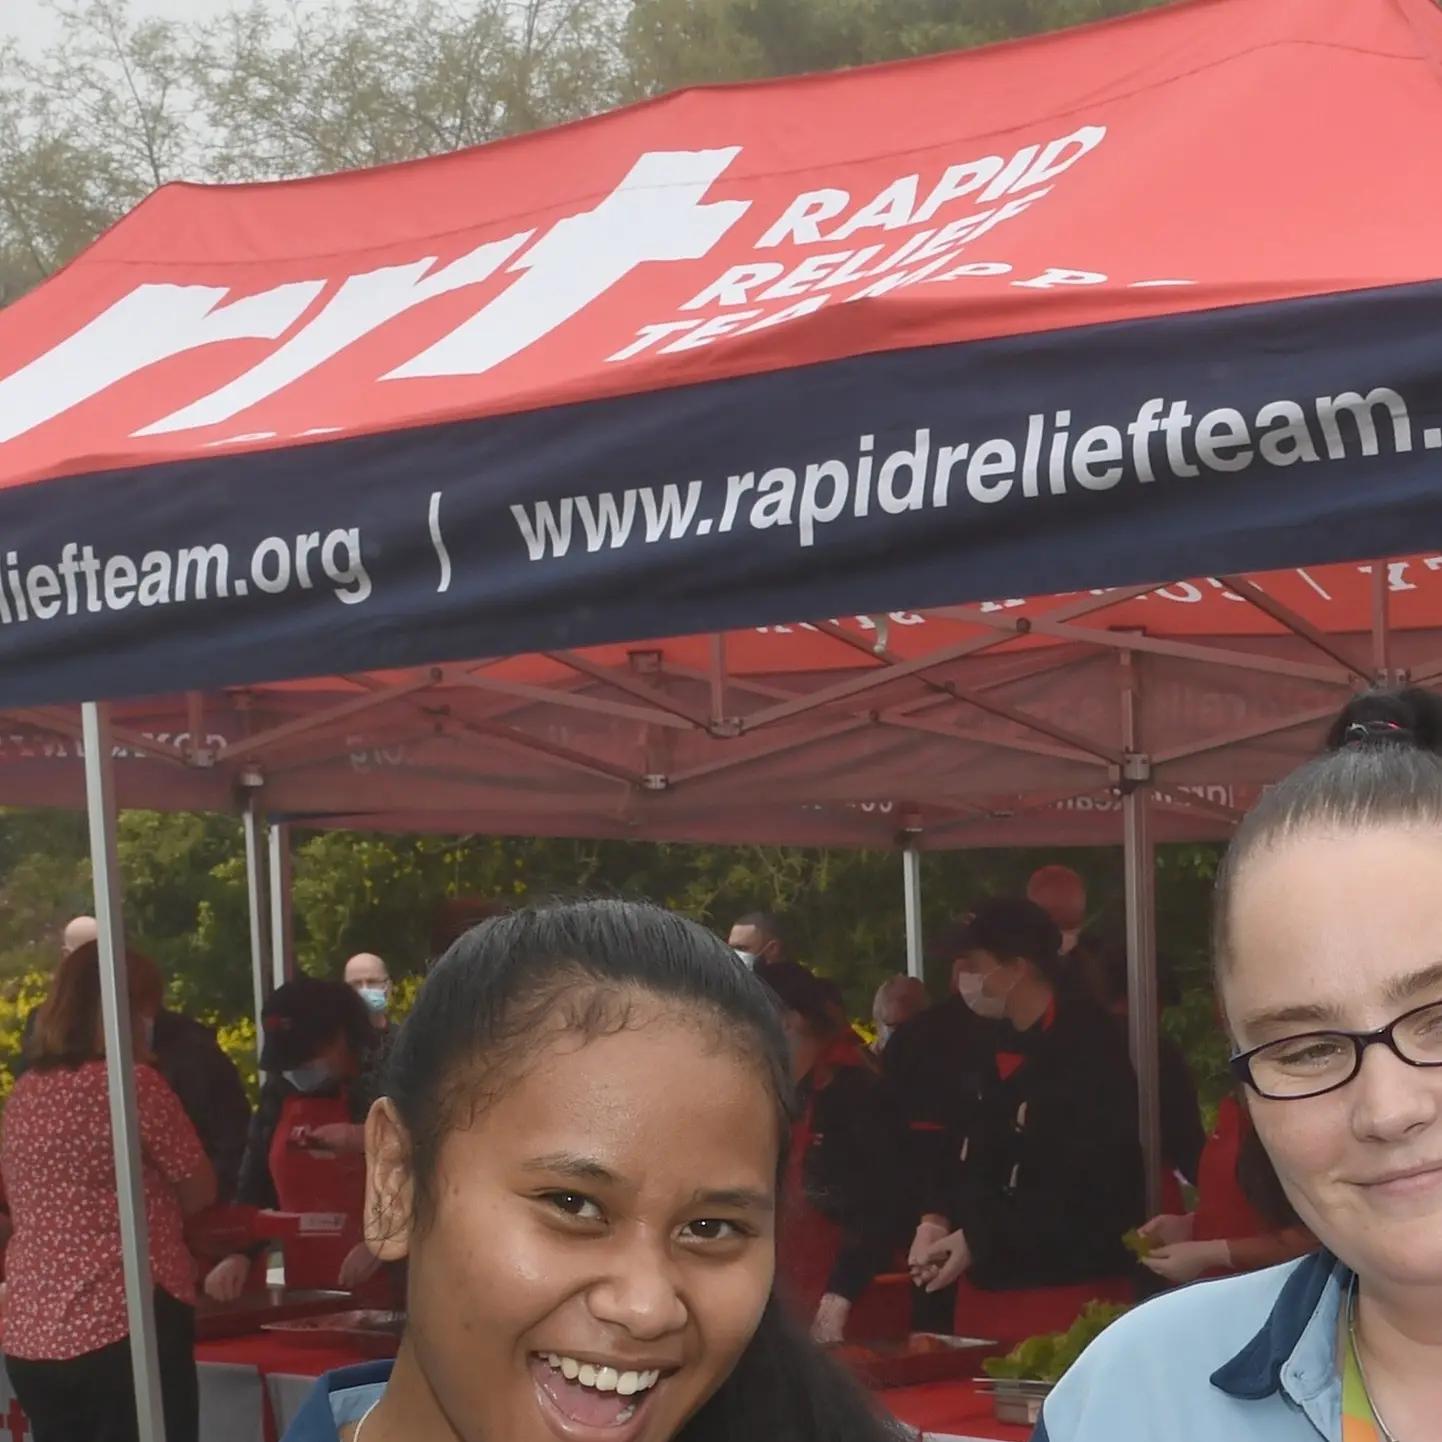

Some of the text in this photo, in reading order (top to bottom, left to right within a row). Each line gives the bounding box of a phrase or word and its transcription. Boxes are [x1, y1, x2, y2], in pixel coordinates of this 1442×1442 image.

[679, 184, 1055, 311] RELIEF
[753, 125, 1107, 250] RAPID
[0, 146, 752, 443] rrt
